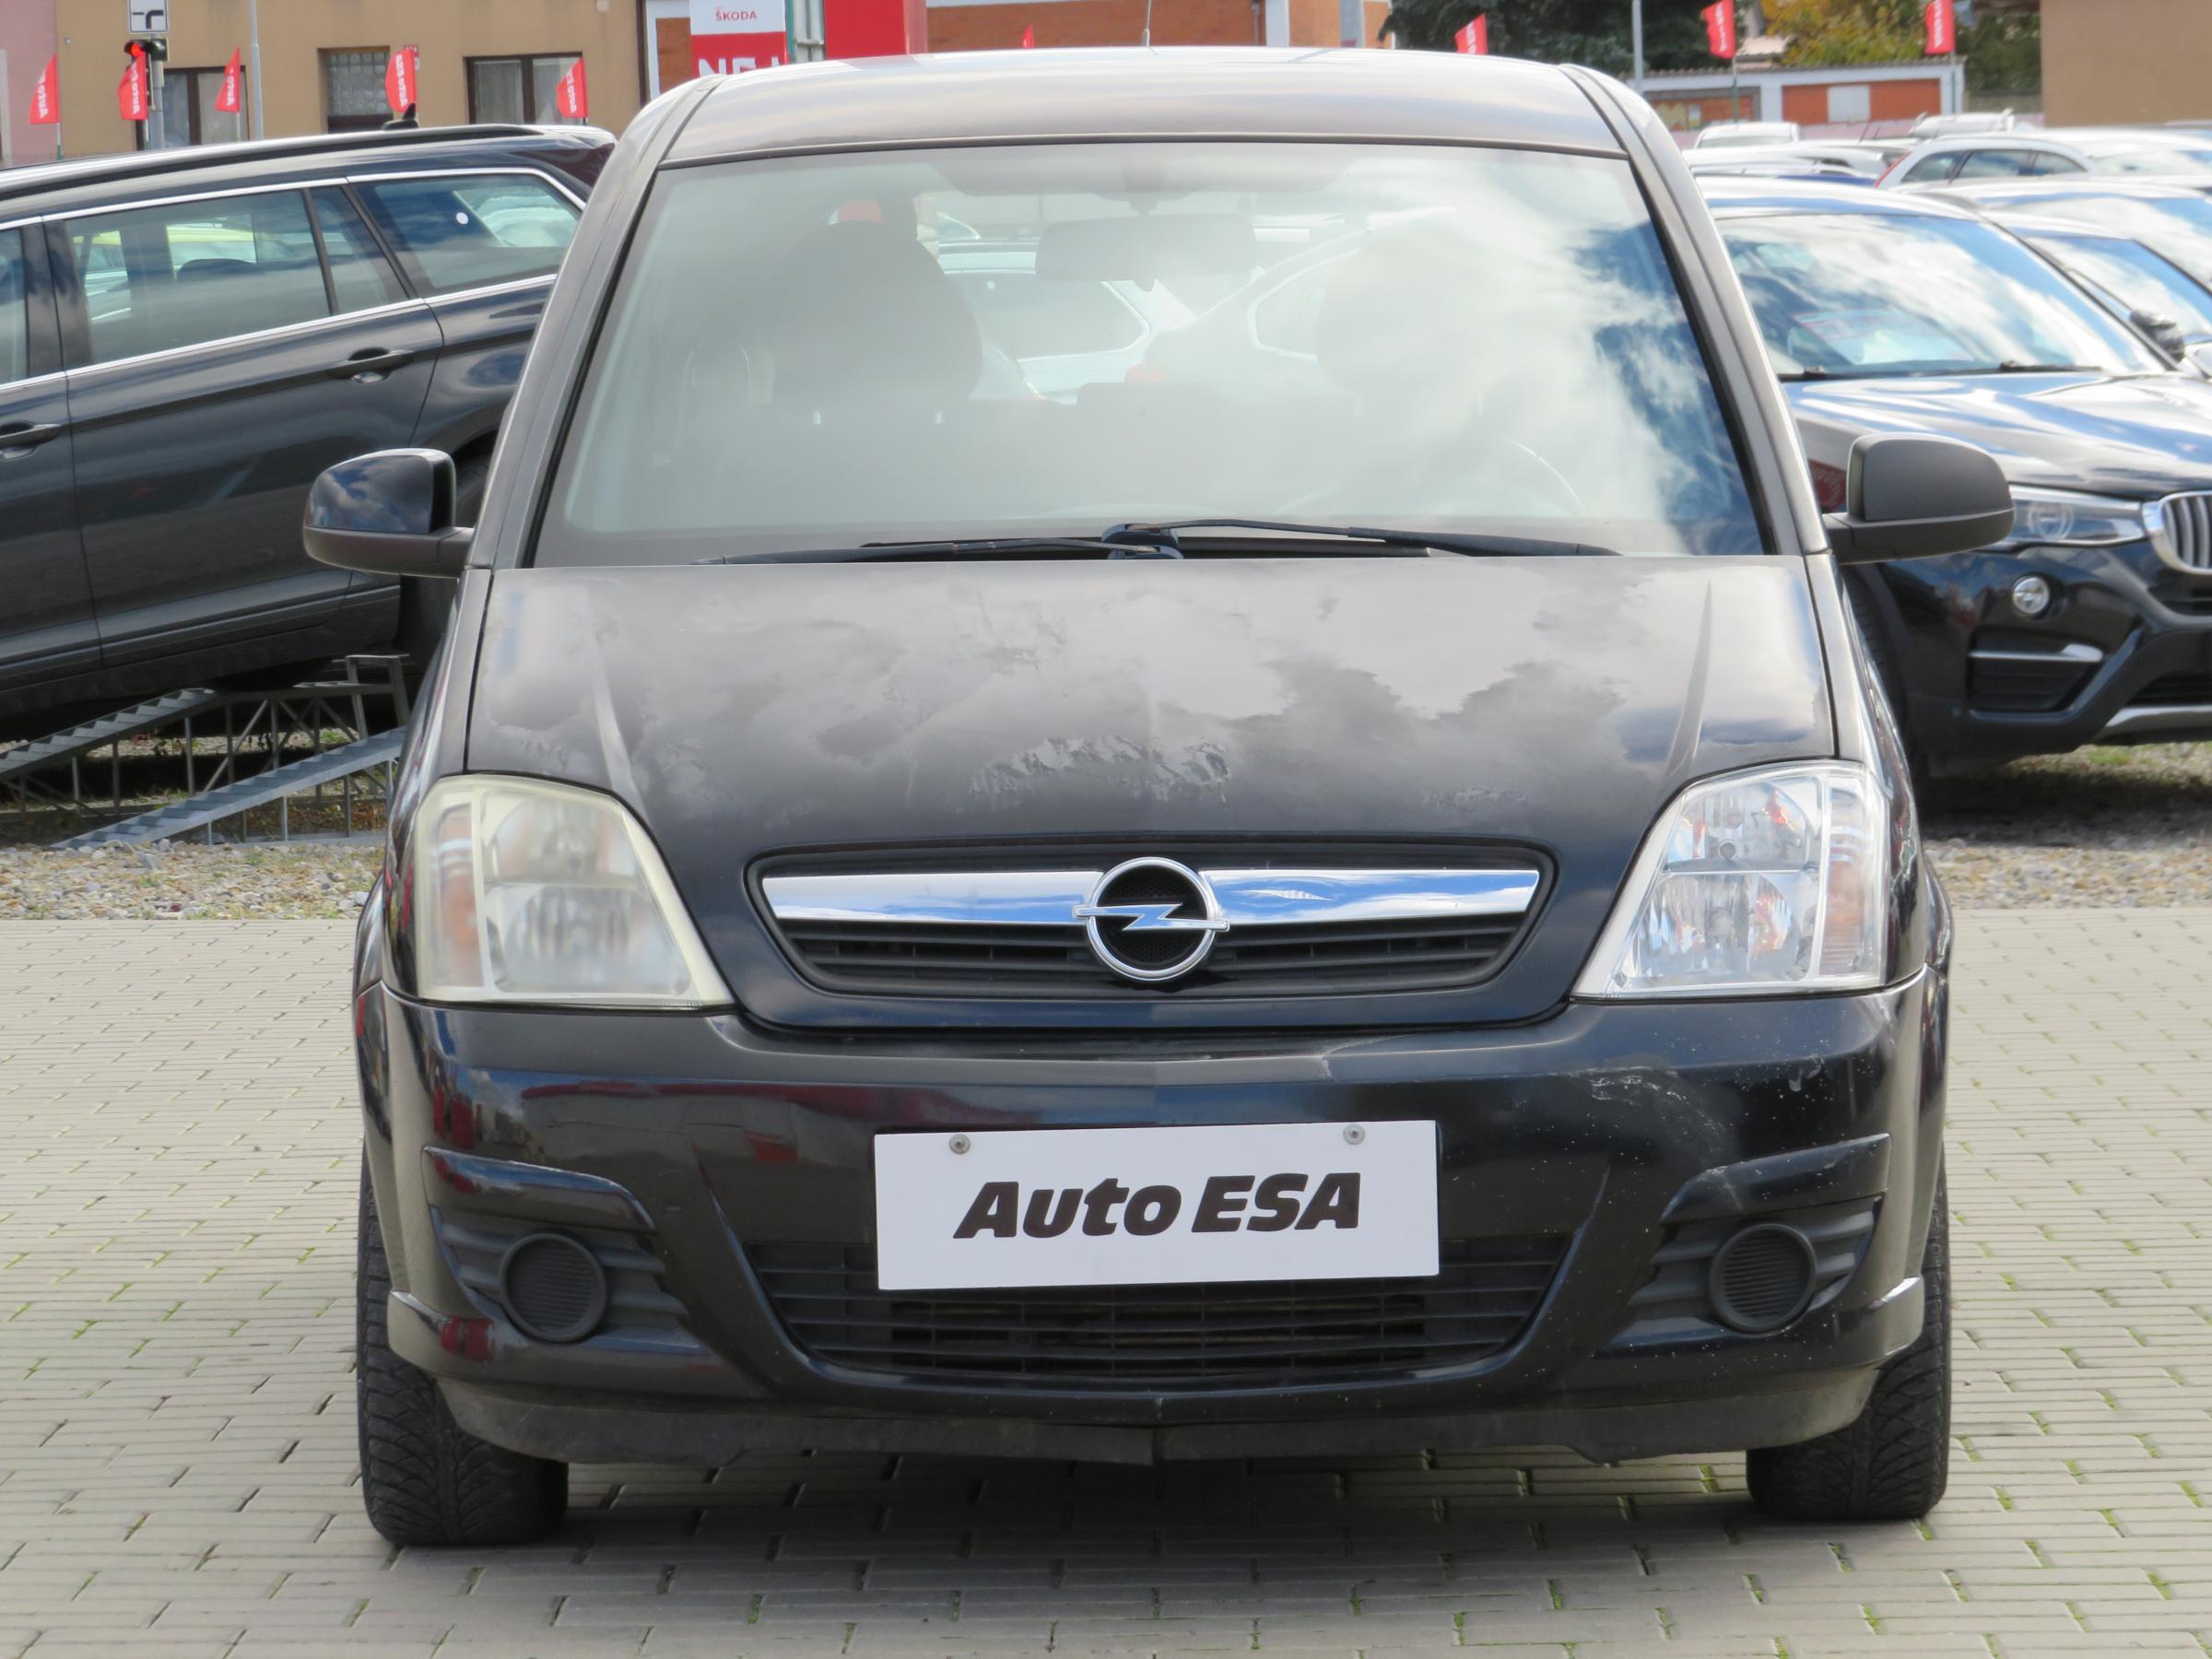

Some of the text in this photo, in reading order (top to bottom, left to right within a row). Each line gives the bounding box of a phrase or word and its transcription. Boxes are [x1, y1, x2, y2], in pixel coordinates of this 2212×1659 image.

[715, 6, 758, 21] ŠKODA
[953, 1171, 1361, 1240] Auto ESA
